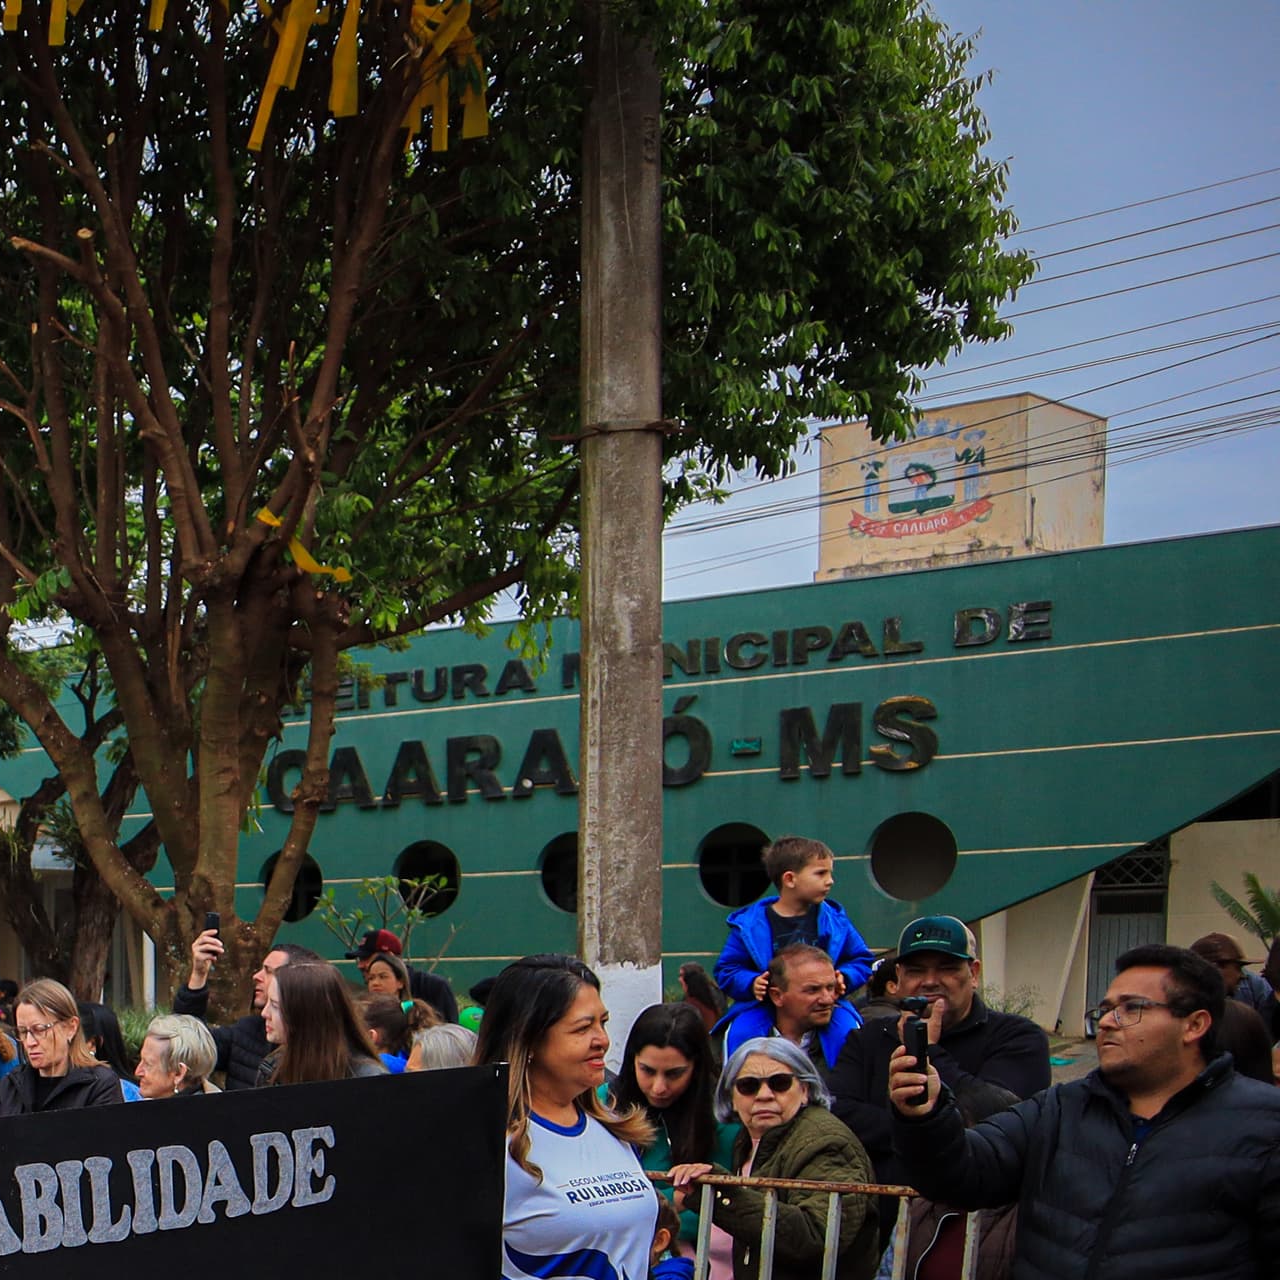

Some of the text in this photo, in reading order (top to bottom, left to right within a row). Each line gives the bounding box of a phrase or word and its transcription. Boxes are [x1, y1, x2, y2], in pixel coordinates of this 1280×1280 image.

[562, 616, 924, 689] NICIPAL
[952, 600, 1054, 648] DE
[566, 1187, 596, 1204] RUI
[594, 1179, 650, 1197] BARBOSA
